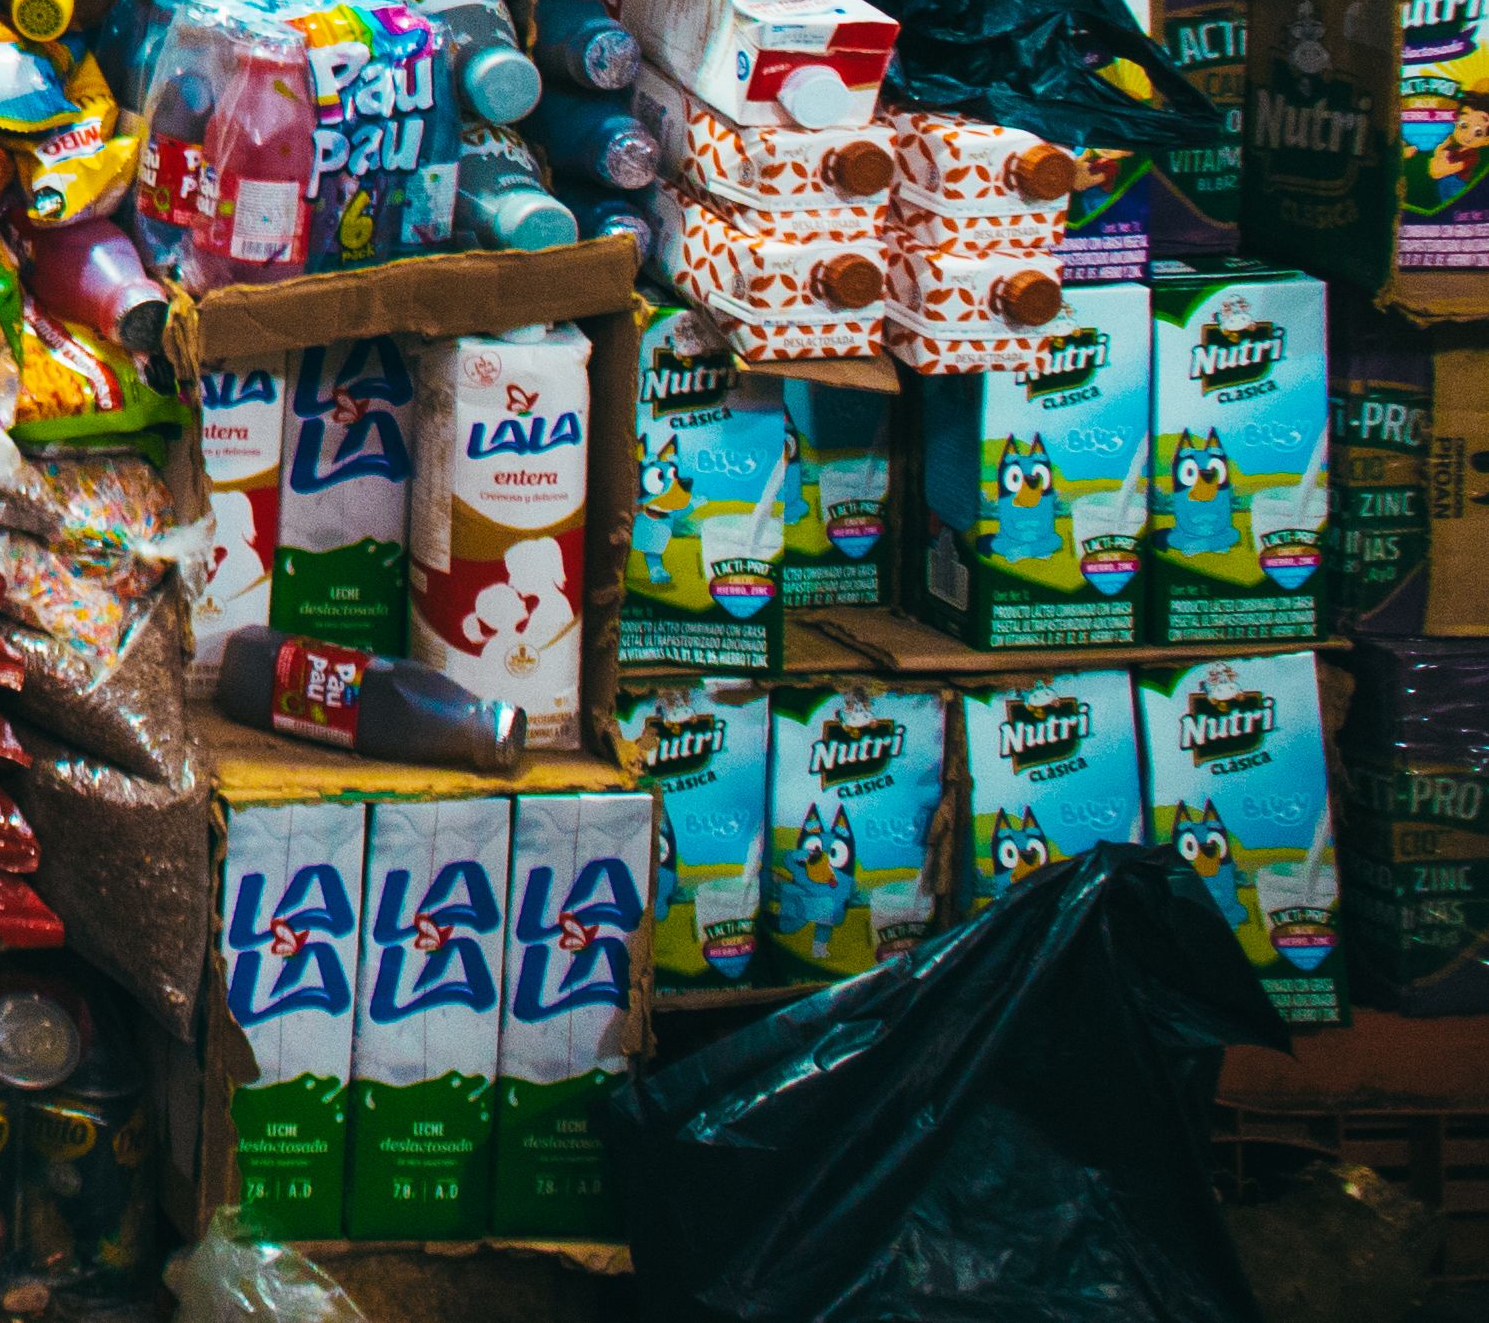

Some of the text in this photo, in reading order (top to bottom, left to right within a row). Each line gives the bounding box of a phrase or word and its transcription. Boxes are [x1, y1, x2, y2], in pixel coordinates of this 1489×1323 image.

[307, 40, 435, 124] Pau
[1252, 87, 1372, 157] Nutri
[305, 117, 425, 200] pau
[340, 191, 374, 250] 6
[791, 218, 861, 234] DESLACTOSADA
[972, 226, 1041, 241] DESLACTOSADA
[783, 336, 856, 351] DESLACTOSADA
[1190, 320, 1286, 380] Nutri
[468, 412, 583, 459] LALA
[494, 469, 559, 488] entera
[1360, 492, 1417, 517] ZINC
[999, 703, 1091, 755] Nutri
[1180, 695, 1276, 750] Nutri
[810, 724, 905, 773] Nutri
[380, 1137, 474, 1154] deslactosada
[413, 1121, 445, 1137] LECHE
